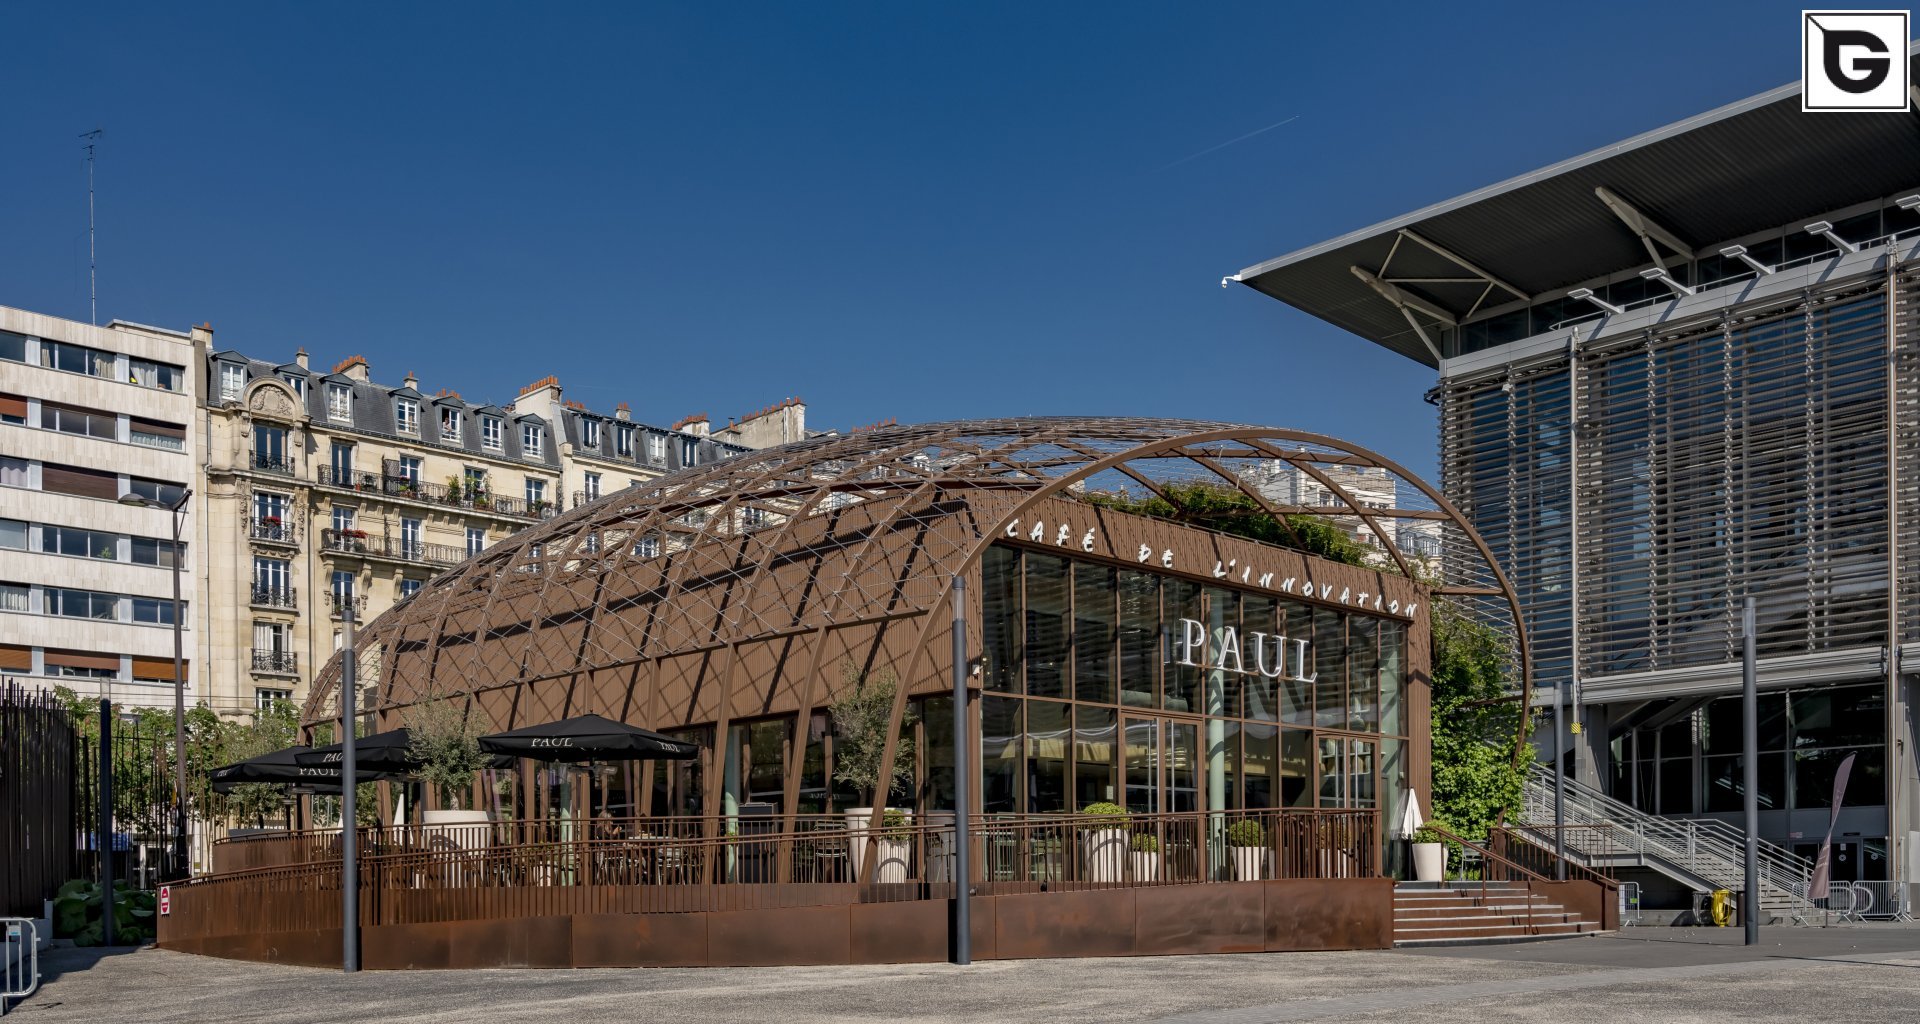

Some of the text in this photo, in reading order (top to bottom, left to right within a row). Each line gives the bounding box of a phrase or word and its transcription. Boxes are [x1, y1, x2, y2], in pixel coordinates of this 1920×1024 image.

[1004, 518, 1418, 618] CAFÉ DE L'INNOVATION
[1177, 618, 1318, 683] PAUL
[531, 737, 574, 748] PAUL
[322, 752, 344, 763] PAU
[298, 767, 340, 777] PAUL
